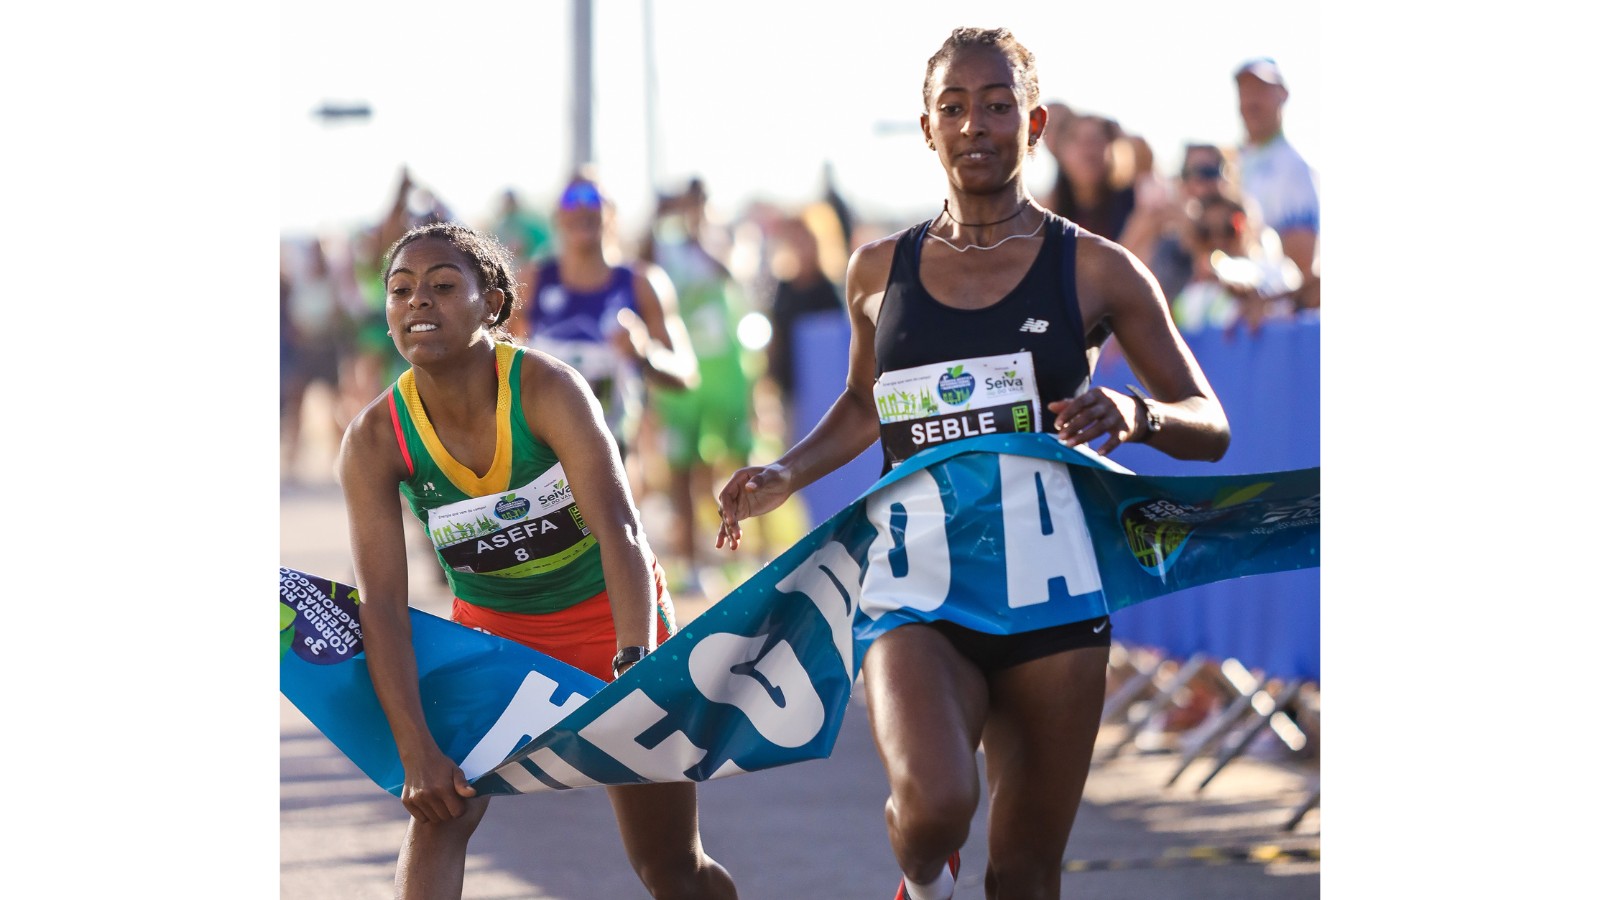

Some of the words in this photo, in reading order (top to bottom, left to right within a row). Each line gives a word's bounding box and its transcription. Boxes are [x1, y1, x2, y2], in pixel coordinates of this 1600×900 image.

[985, 376, 1024, 391] Seiva
[911, 412, 997, 445] SEBLE
[538, 485, 571, 505] Seiva
[477, 519, 559, 554] ASEFA
[514, 548, 530, 562] 8
[296, 600, 348, 655] CORRIDA
